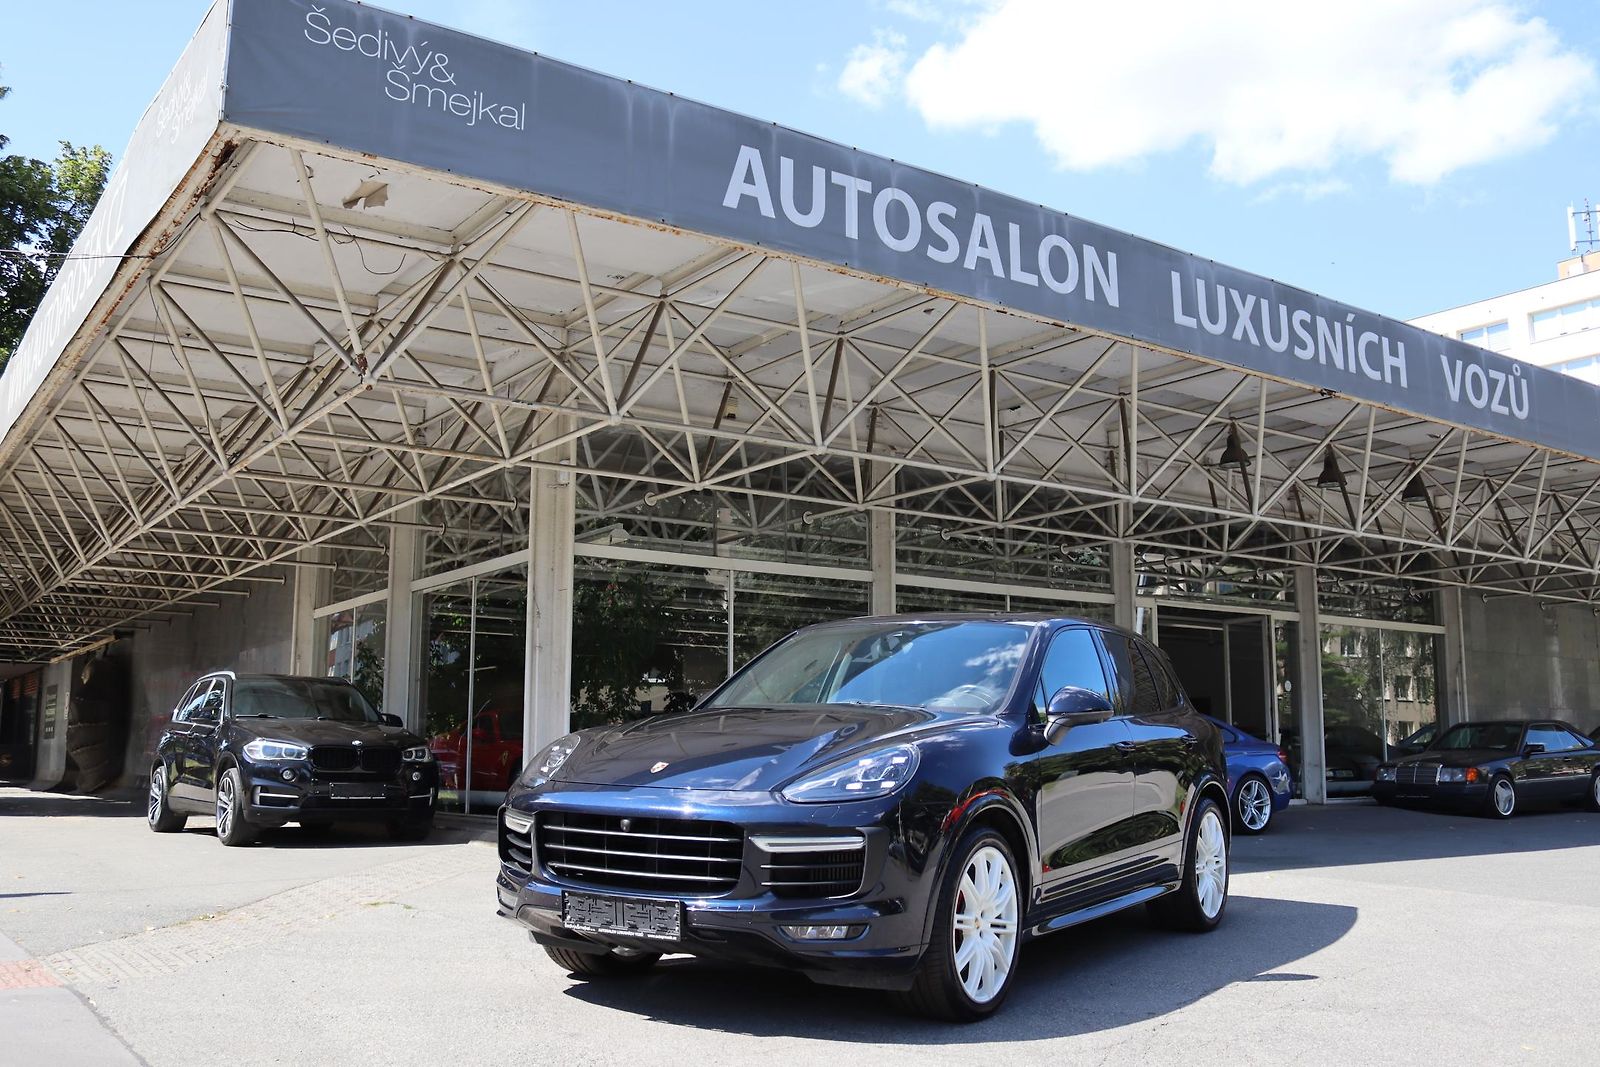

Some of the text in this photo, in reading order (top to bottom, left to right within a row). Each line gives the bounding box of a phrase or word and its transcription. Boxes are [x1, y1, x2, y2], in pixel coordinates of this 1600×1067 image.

[385, 62, 525, 131] Šmejkal
[722, 144, 1529, 420] AUTOSALON LUXUSNÍCH VOZŮ
